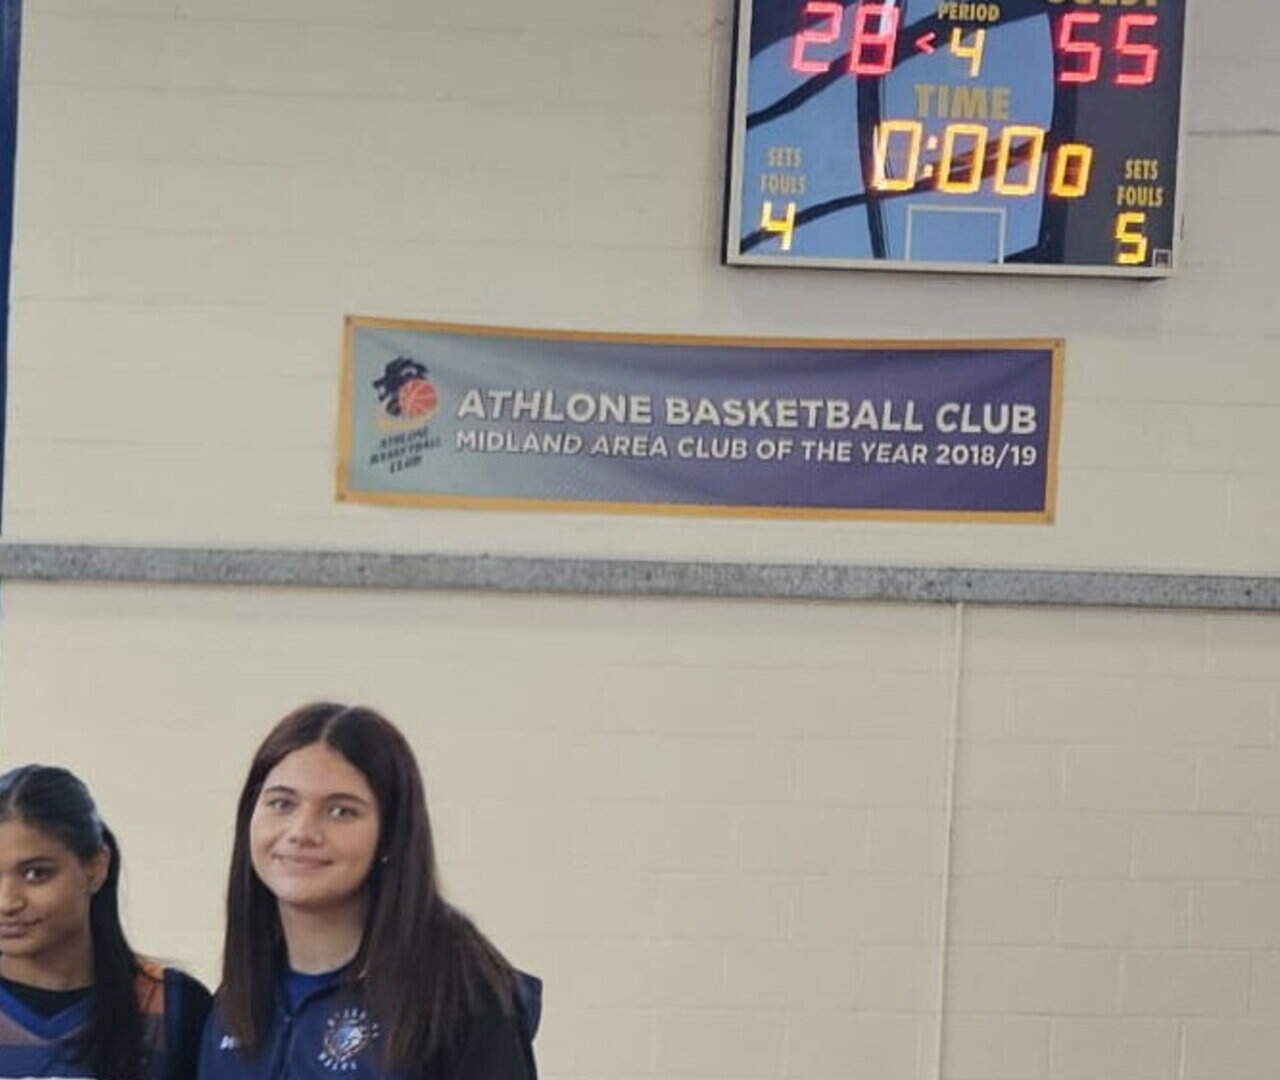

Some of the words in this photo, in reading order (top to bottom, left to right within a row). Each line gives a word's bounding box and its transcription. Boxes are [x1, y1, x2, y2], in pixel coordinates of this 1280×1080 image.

[938, 3, 1000, 21] PERIOD
[791, 1, 900, 75] 28
[950, 27, 986, 77] 4
[1059, 11, 1158, 85] 55
[914, 85, 1011, 120] TIME
[767, 147, 802, 168] SETS
[1125, 159, 1158, 180] SETS
[760, 174, 806, 195] FOULS
[1117, 185, 1163, 207] FOULS
[759, 201, 796, 250] 4
[1115, 212, 1147, 264] 5
[457, 388, 652, 424] ATHLONE
[665, 397, 924, 432] BASKETBALL
[936, 403, 1038, 434] CLUB
[456, 430, 582, 455] MIDLAND
[590, 436, 668, 458] AREA
[678, 439, 748, 460] CLUB
[756, 440, 793, 461] OF
[801, 440, 851, 463] THE
[861, 442, 928, 465] YEAR
[936, 443, 1038, 470] 2018/19
